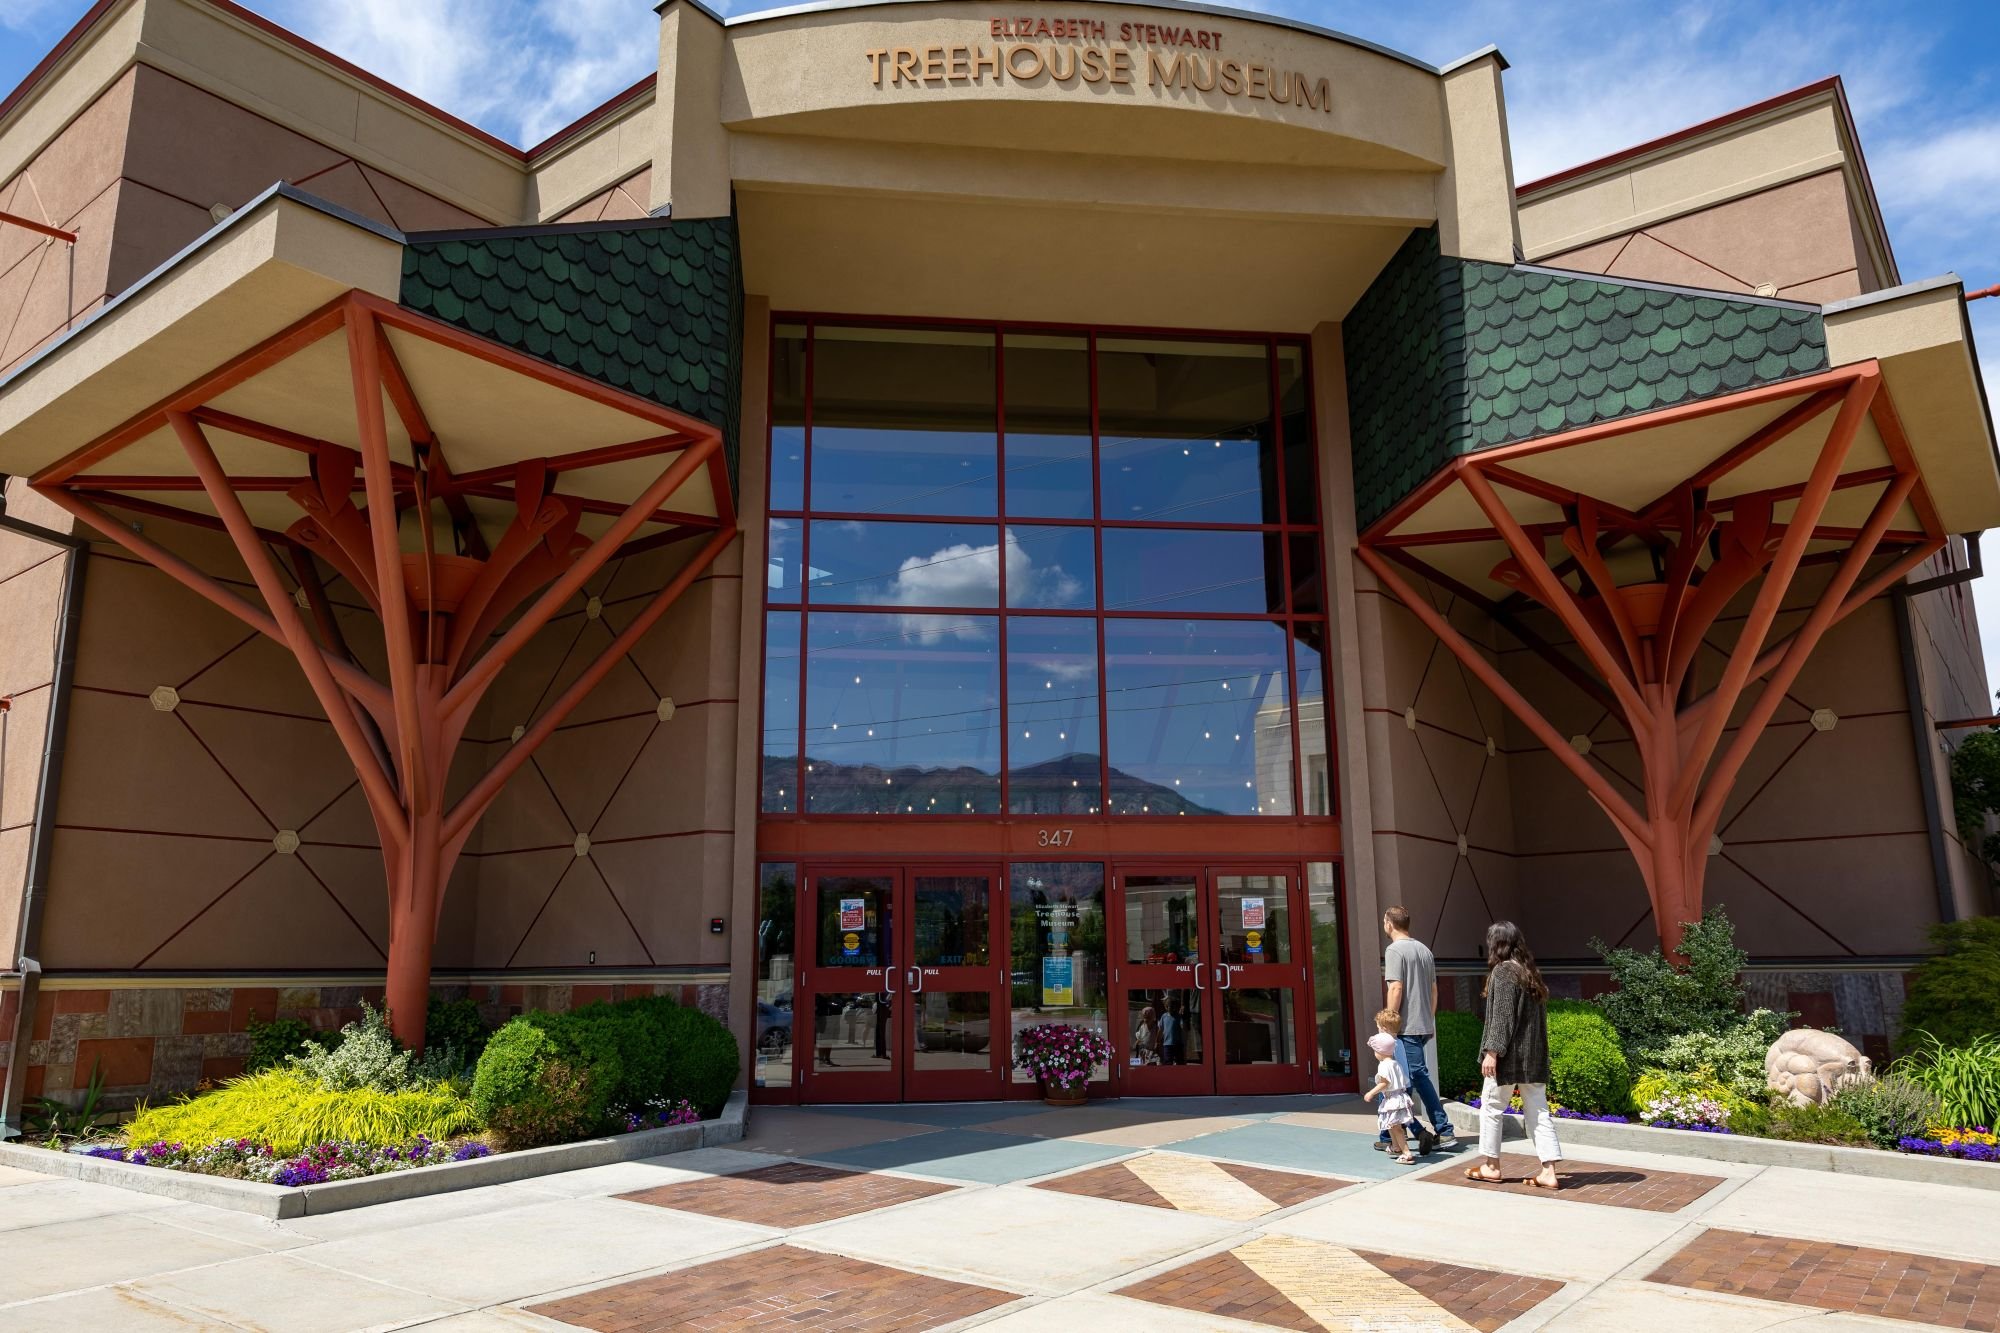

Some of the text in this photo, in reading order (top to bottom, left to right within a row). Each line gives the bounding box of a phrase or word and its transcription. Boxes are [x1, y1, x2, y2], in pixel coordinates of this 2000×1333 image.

[990, 17, 1222, 51] ELIZABETH STEWART
[866, 43, 1331, 112] TREEHOUSE MUSEUM
[1038, 829, 1073, 847] 347
[1035, 910, 1080, 918] Treehouse
